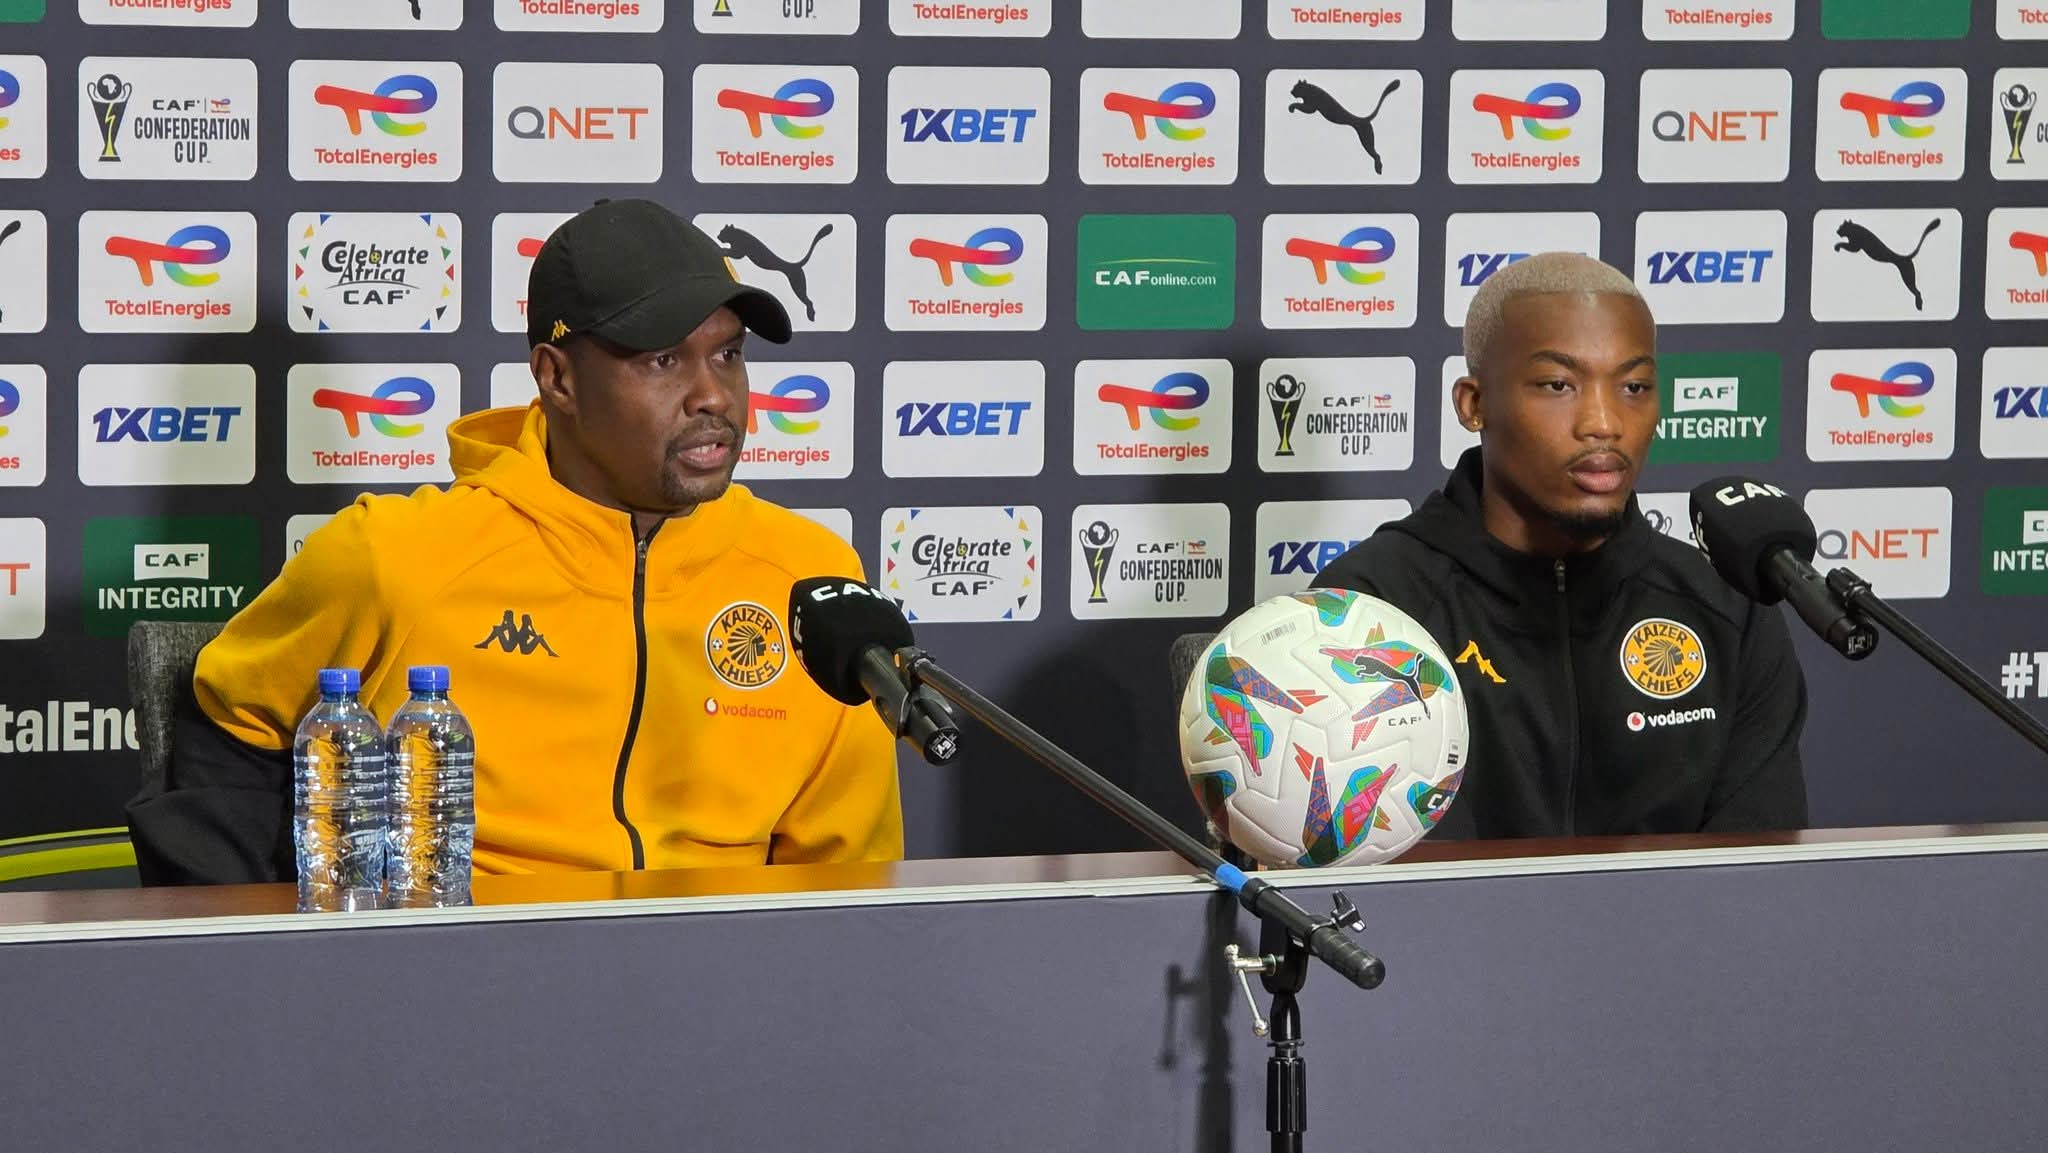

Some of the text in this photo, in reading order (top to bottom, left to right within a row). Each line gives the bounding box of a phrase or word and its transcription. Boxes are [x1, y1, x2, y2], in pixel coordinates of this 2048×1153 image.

[519, 0, 640, 19] TotalEnergies
[782, 0, 814, 18] CUP
[912, 4, 1029, 24] TotalEnergies
[1290, 7, 1402, 27] TotalEnergies
[1664, 8, 1773, 28] TotalEnergies
[152, 99, 196, 111] CAF
[134, 117, 250, 140] CONFEDERATION
[508, 106, 649, 140] QNET
[900, 108, 1036, 143] 1XBET
[1652, 110, 1779, 142] QNET
[174, 141, 208, 163] CUP
[314, 148, 438, 168] TotalEnergies
[716, 150, 834, 170] TotalEnergies
[1102, 151, 1216, 172] TotalEnergies
[1471, 151, 1581, 171] TotalEnergies
[1838, 149, 1944, 169] TotalEnergies
[321, 240, 429, 273] Celebrate
[338, 262, 406, 285] Africa
[1647, 250, 1774, 285] 1XBET
[343, 289, 405, 305] CAF
[1284, 296, 1395, 316] TotalEnergies
[105, 299, 232, 321] TotalEnergies
[908, 298, 1024, 318] TotalEnergies
[1323, 396, 1361, 408] CAF
[1683, 387, 1729, 400] CAF
[92, 406, 241, 443] 1XBET
[896, 401, 1031, 437] 1XBET
[1306, 412, 1408, 434] CONFEDERATION
[1655, 416, 1768, 439] NTEGRITY
[1341, 435, 1371, 455] CUP
[1829, 428, 1934, 448] TotalEnergies
[312, 448, 435, 470] TotalEnergies
[739, 446, 830, 466] alEnergies
[1097, 441, 1210, 462] TotalEnergies
[912, 534, 1012, 566] Celebrate
[1137, 543, 1175, 554] CAF
[1816, 529, 1939, 560] QNET
[145, 553, 199, 567] CAF
[927, 556, 990, 577] Africa
[1120, 558, 1223, 581] CONFEDERATION
[1993, 550, 2048, 572] INTE
[98, 586, 244, 610] INTEGRITY
[931, 581, 988, 596] CAF
[1155, 581, 1185, 602] CUP
[721, 607, 773, 635] KAIZER
[1633, 624, 1688, 649] KAIZER
[718, 657, 777, 684] CHIEFS
[1637, 668, 1695, 692] CHIEFS
[722, 704, 787, 721] vodacom
[1388, 716, 1418, 728] CAF
[1647, 707, 1716, 727] vodacom
